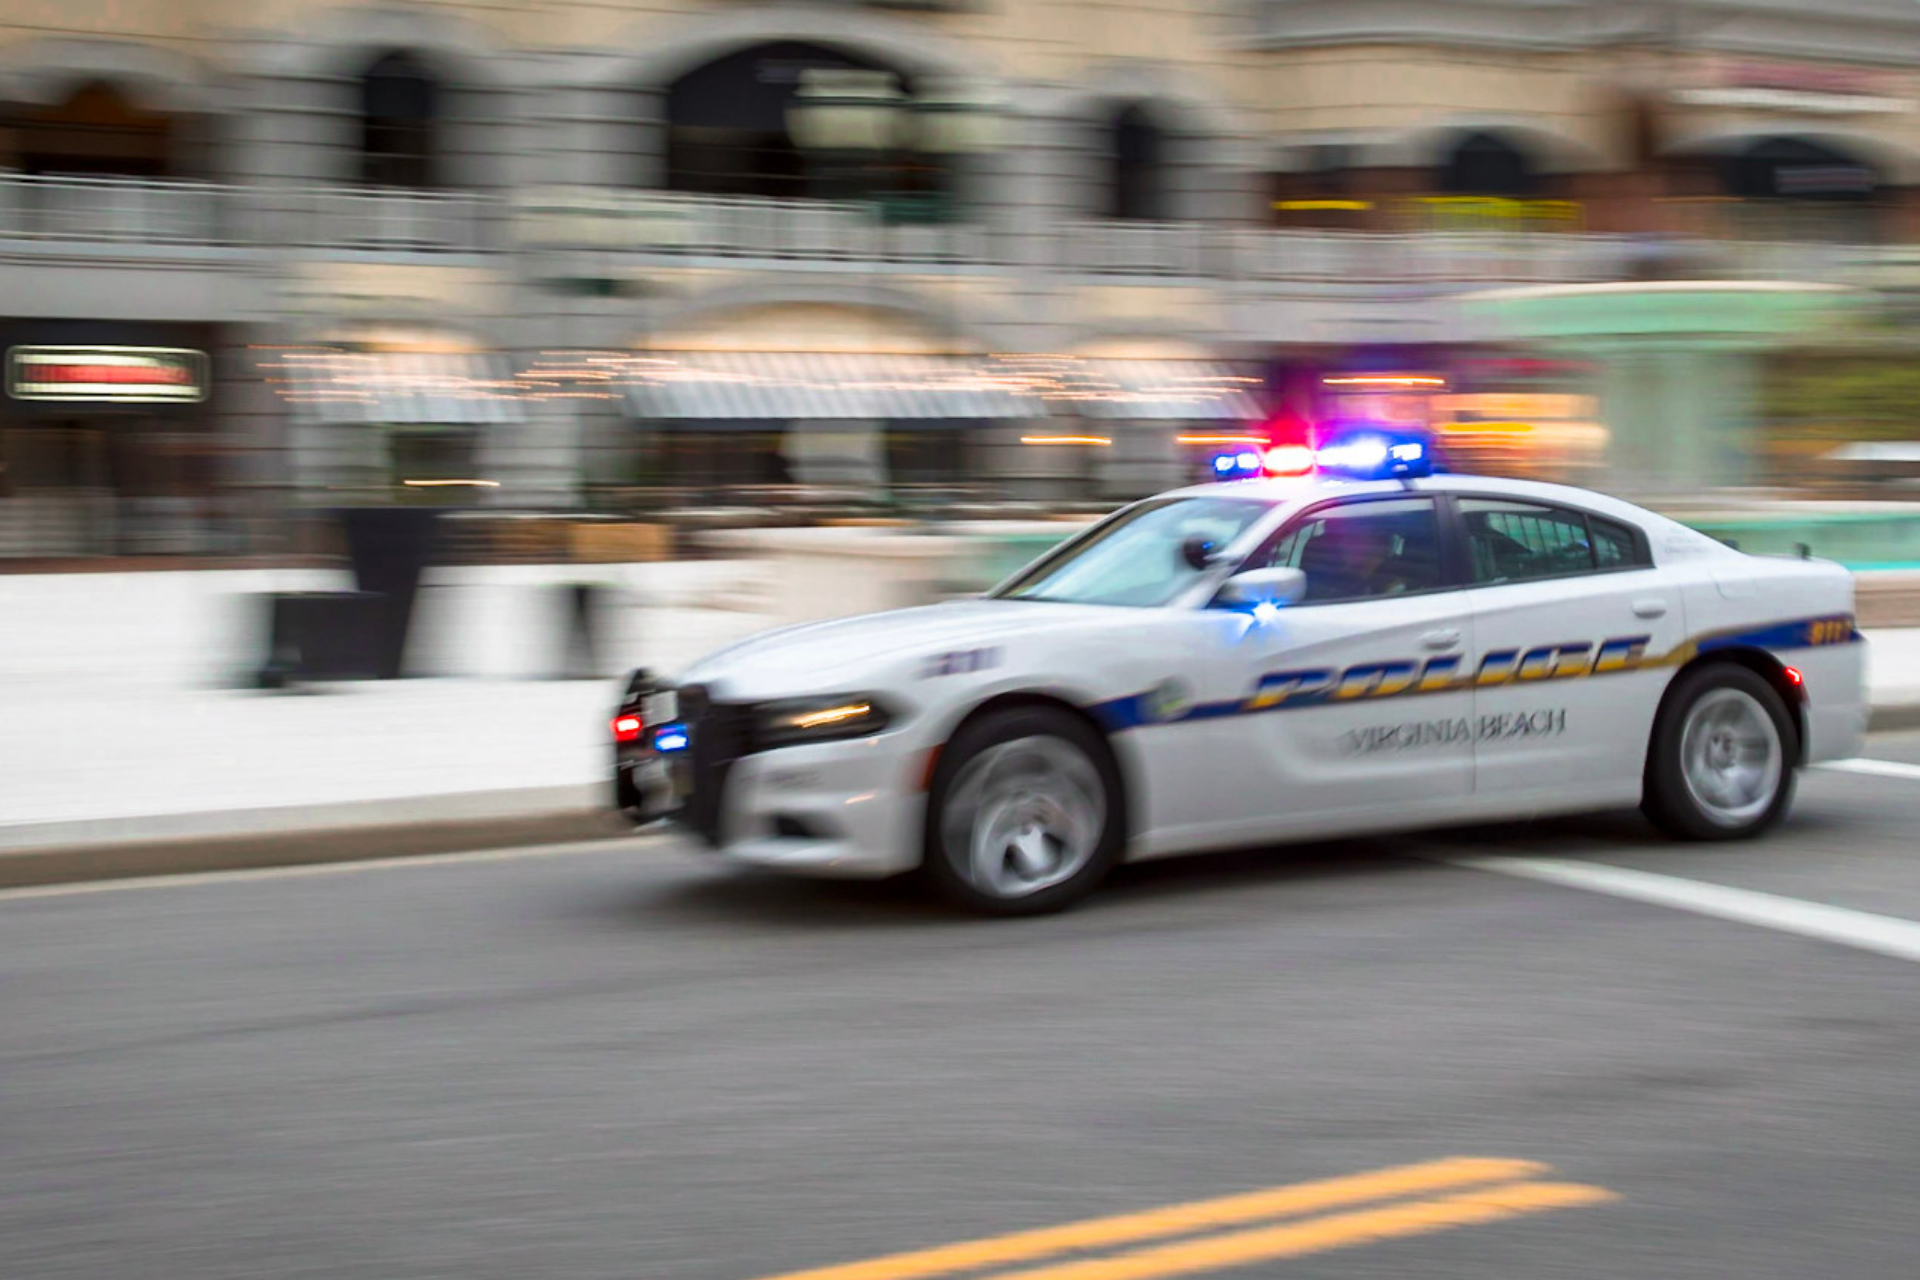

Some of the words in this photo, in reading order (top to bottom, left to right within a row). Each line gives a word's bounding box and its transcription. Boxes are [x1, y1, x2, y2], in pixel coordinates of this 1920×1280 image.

[1246, 634, 1652, 709] POLICE
[1345, 716, 1471, 753] VIRGINIA
[1474, 708, 1568, 742] BEACH
